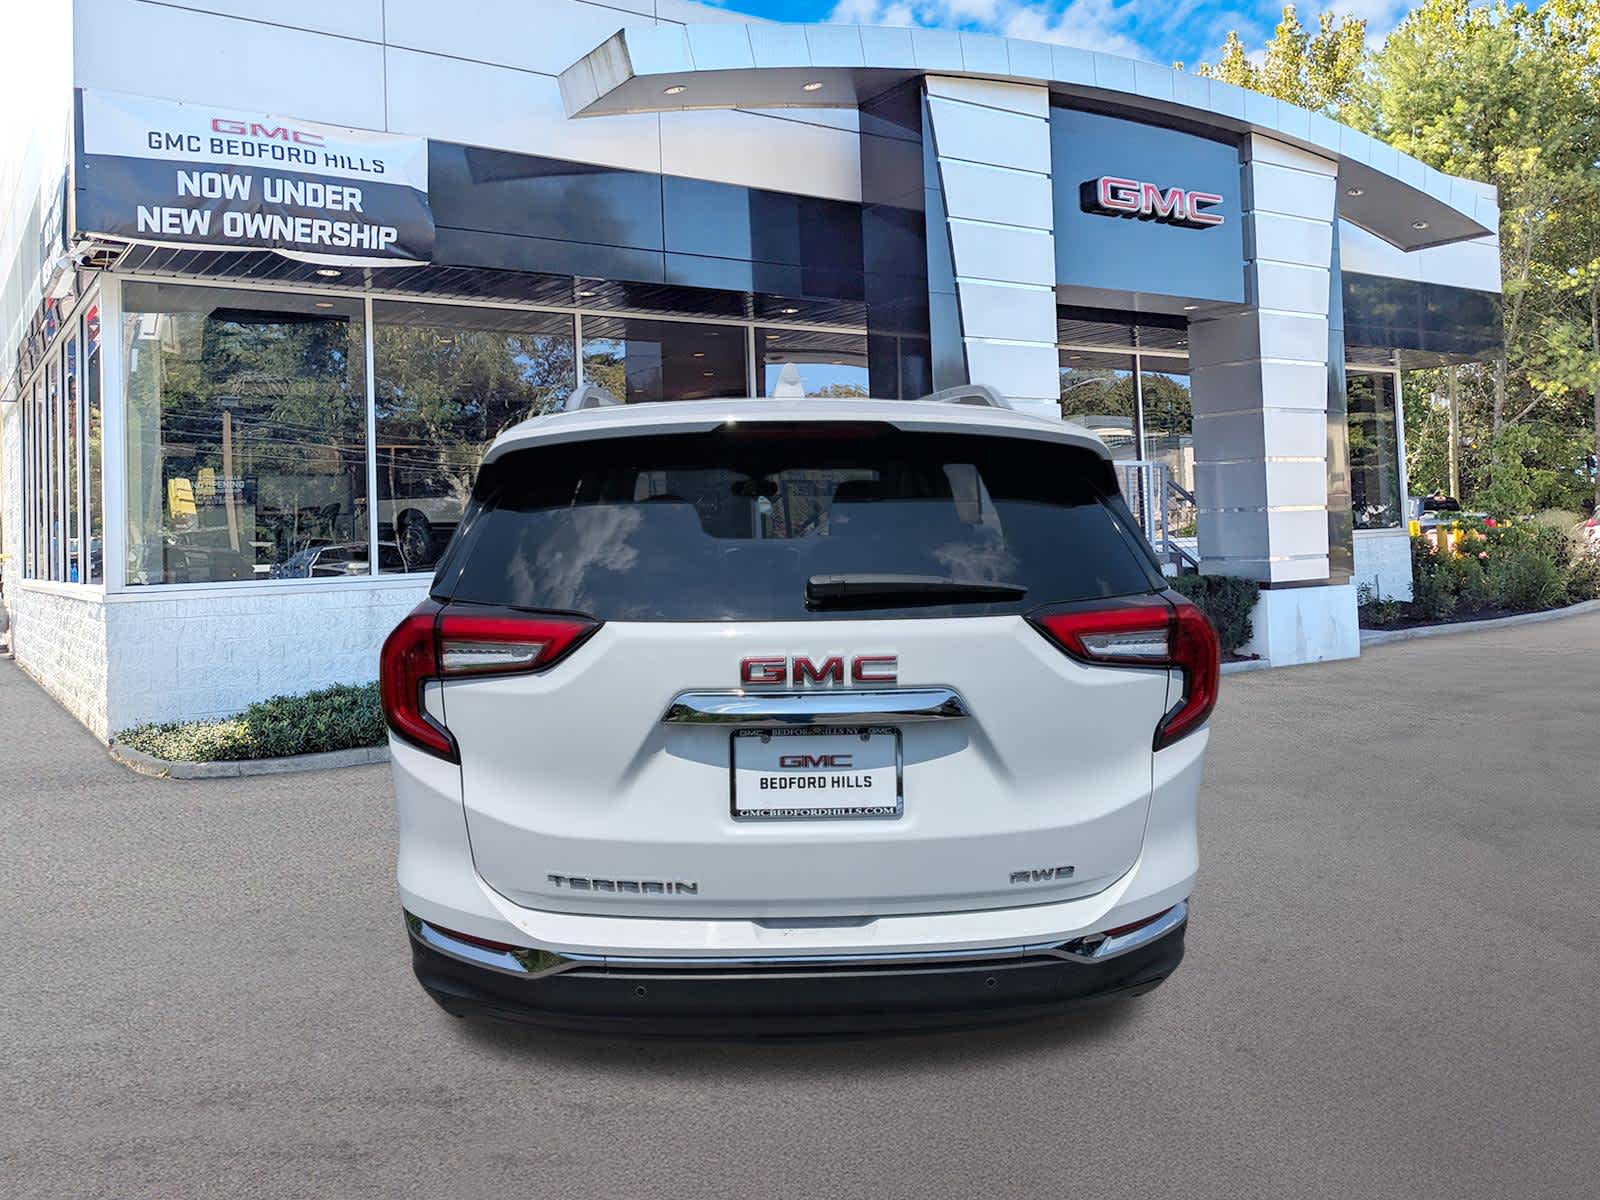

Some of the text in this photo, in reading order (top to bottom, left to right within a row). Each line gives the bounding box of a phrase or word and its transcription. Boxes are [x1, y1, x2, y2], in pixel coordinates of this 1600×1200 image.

[211, 117, 325, 148] GMC
[148, 131, 385, 174] GMC BEDFORD HILLS
[177, 170, 364, 213] NOW UNDER
[1098, 175, 1225, 225] GMC
[136, 206, 398, 250] NEW OWNERSHIP
[740, 655, 898, 688] GMC
[779, 754, 853, 769] GMC
[760, 775, 873, 790] BEDFORD HILLS
[739, 806, 895, 818] GMCBEDFORDHILLS.COM
[547, 873, 699, 895] TERRAIN
[1009, 865, 1076, 884] AWD
